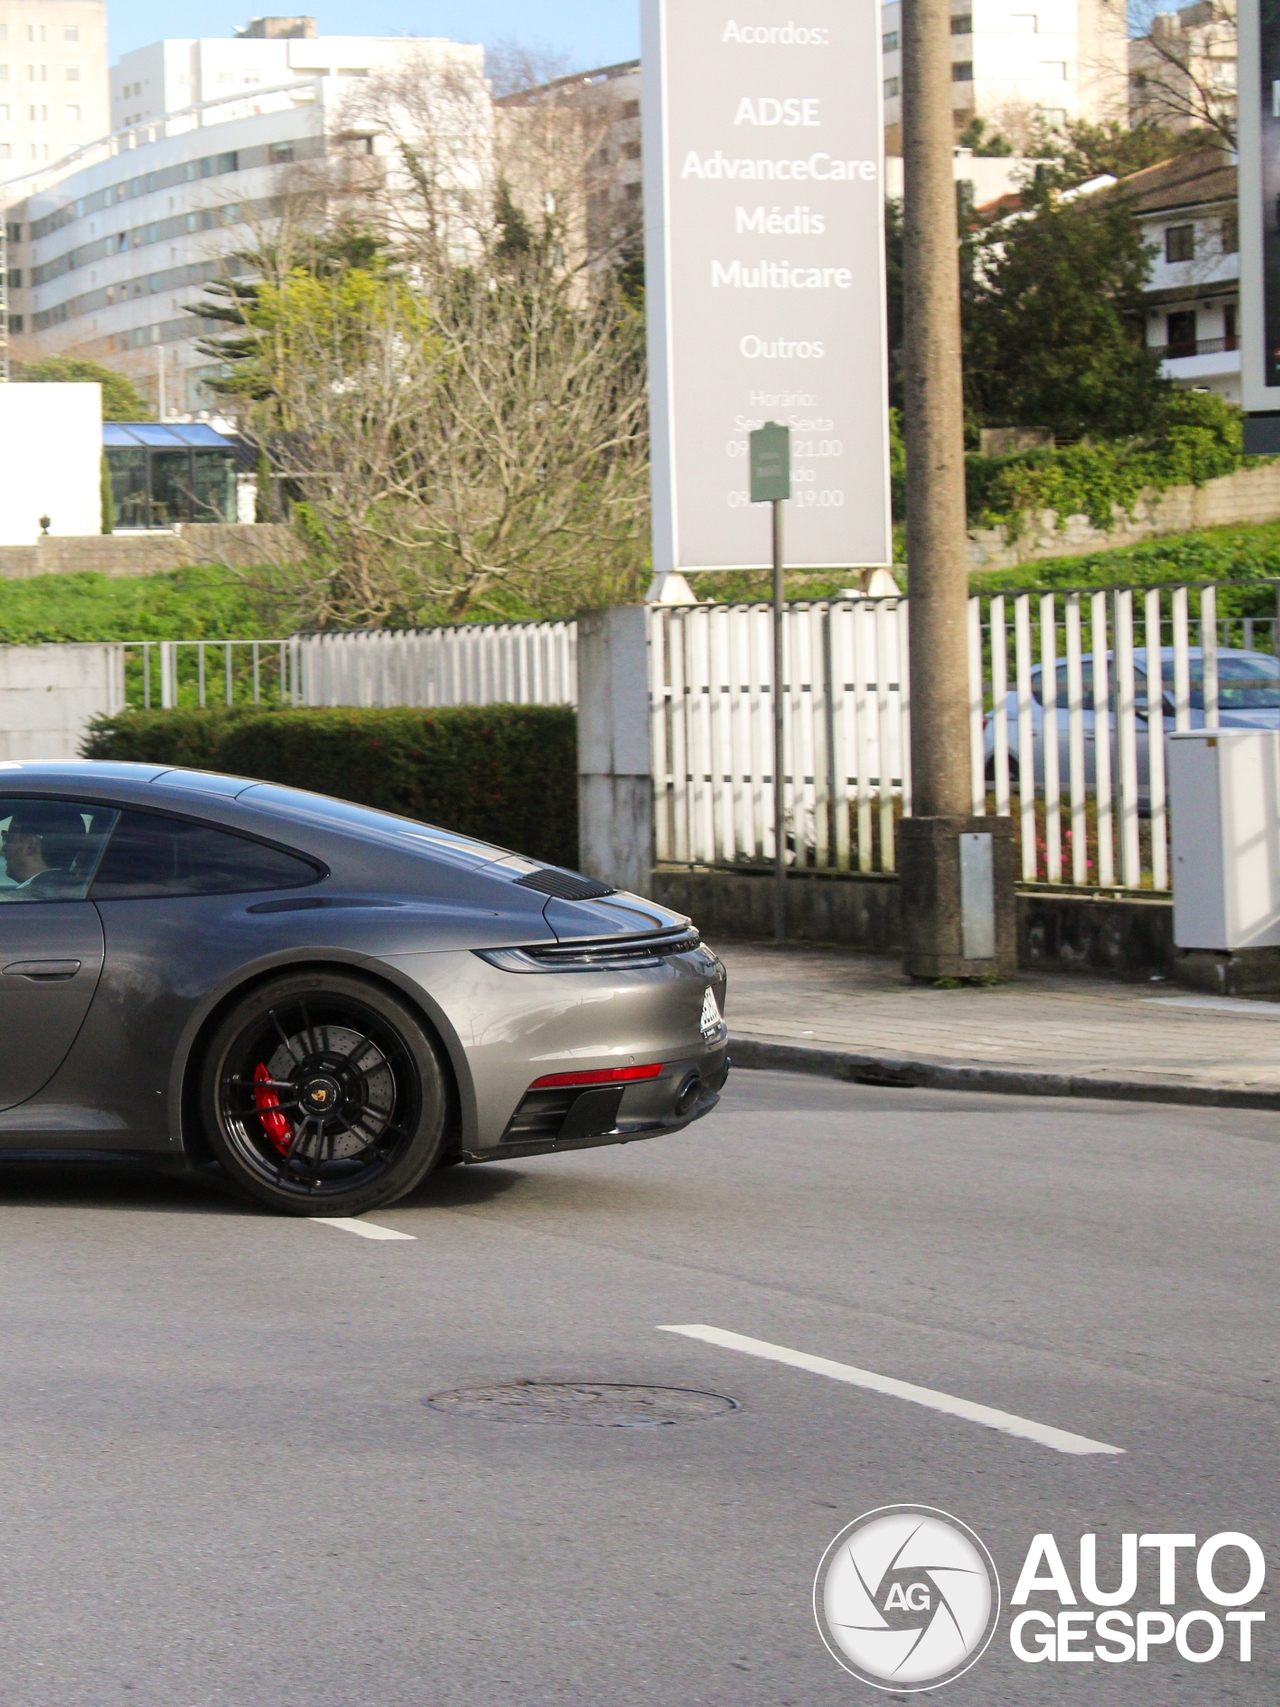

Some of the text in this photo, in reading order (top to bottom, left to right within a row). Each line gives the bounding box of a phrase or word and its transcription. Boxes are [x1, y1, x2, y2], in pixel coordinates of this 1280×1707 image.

[721, 19, 829, 45] Acordos:
[733, 97, 821, 127] ADSE
[680, 150, 877, 181] AdvanceCare
[735, 205, 826, 235] Médis
[710, 259, 853, 288] Multicare
[739, 335, 825, 359] Outros
[749, 390, 818, 407] Horário:
[787, 415, 834, 432] Sexta
